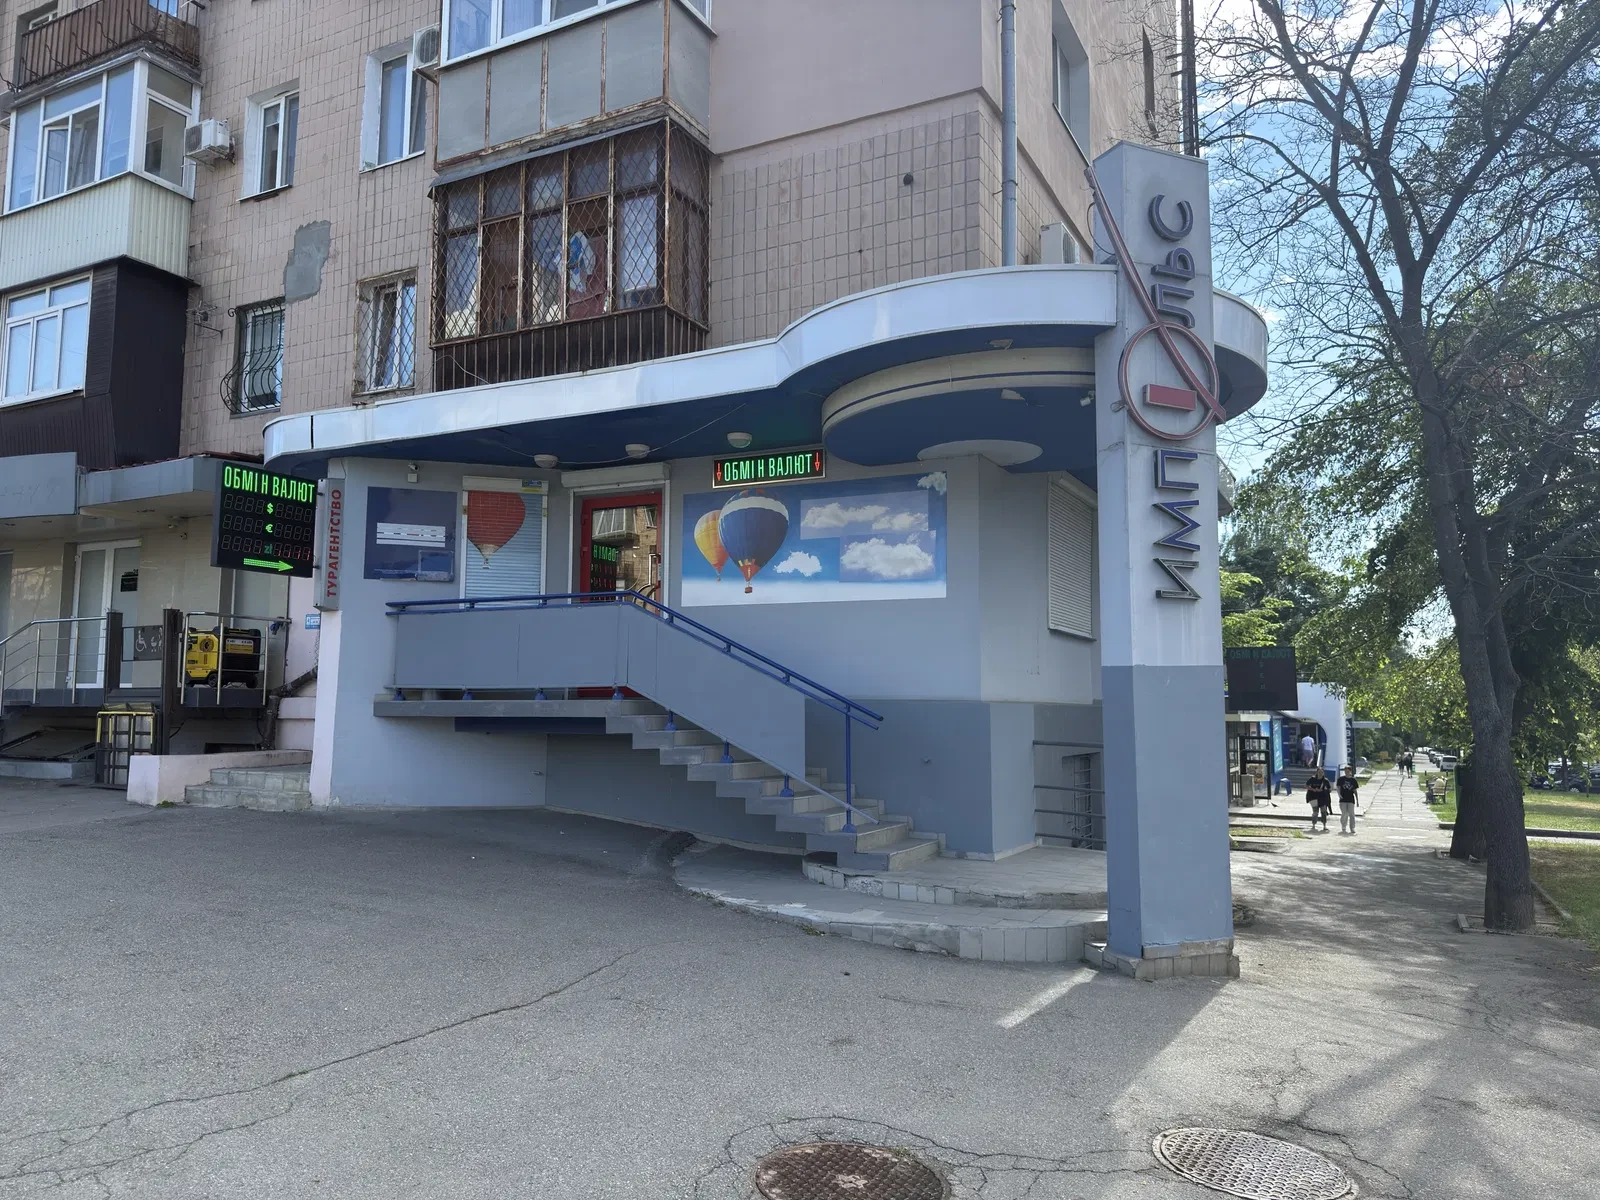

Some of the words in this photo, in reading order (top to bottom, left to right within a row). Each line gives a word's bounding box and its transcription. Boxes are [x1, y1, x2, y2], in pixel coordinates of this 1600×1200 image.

[768, 453, 813, 478] ВАЛЮТ
[272, 477, 316, 503] ВАЛЮТ
[266, 502, 274, 514] $
[265, 524, 274, 533] €
[327, 489, 342, 597] ТУРАГЕНТСТВО
